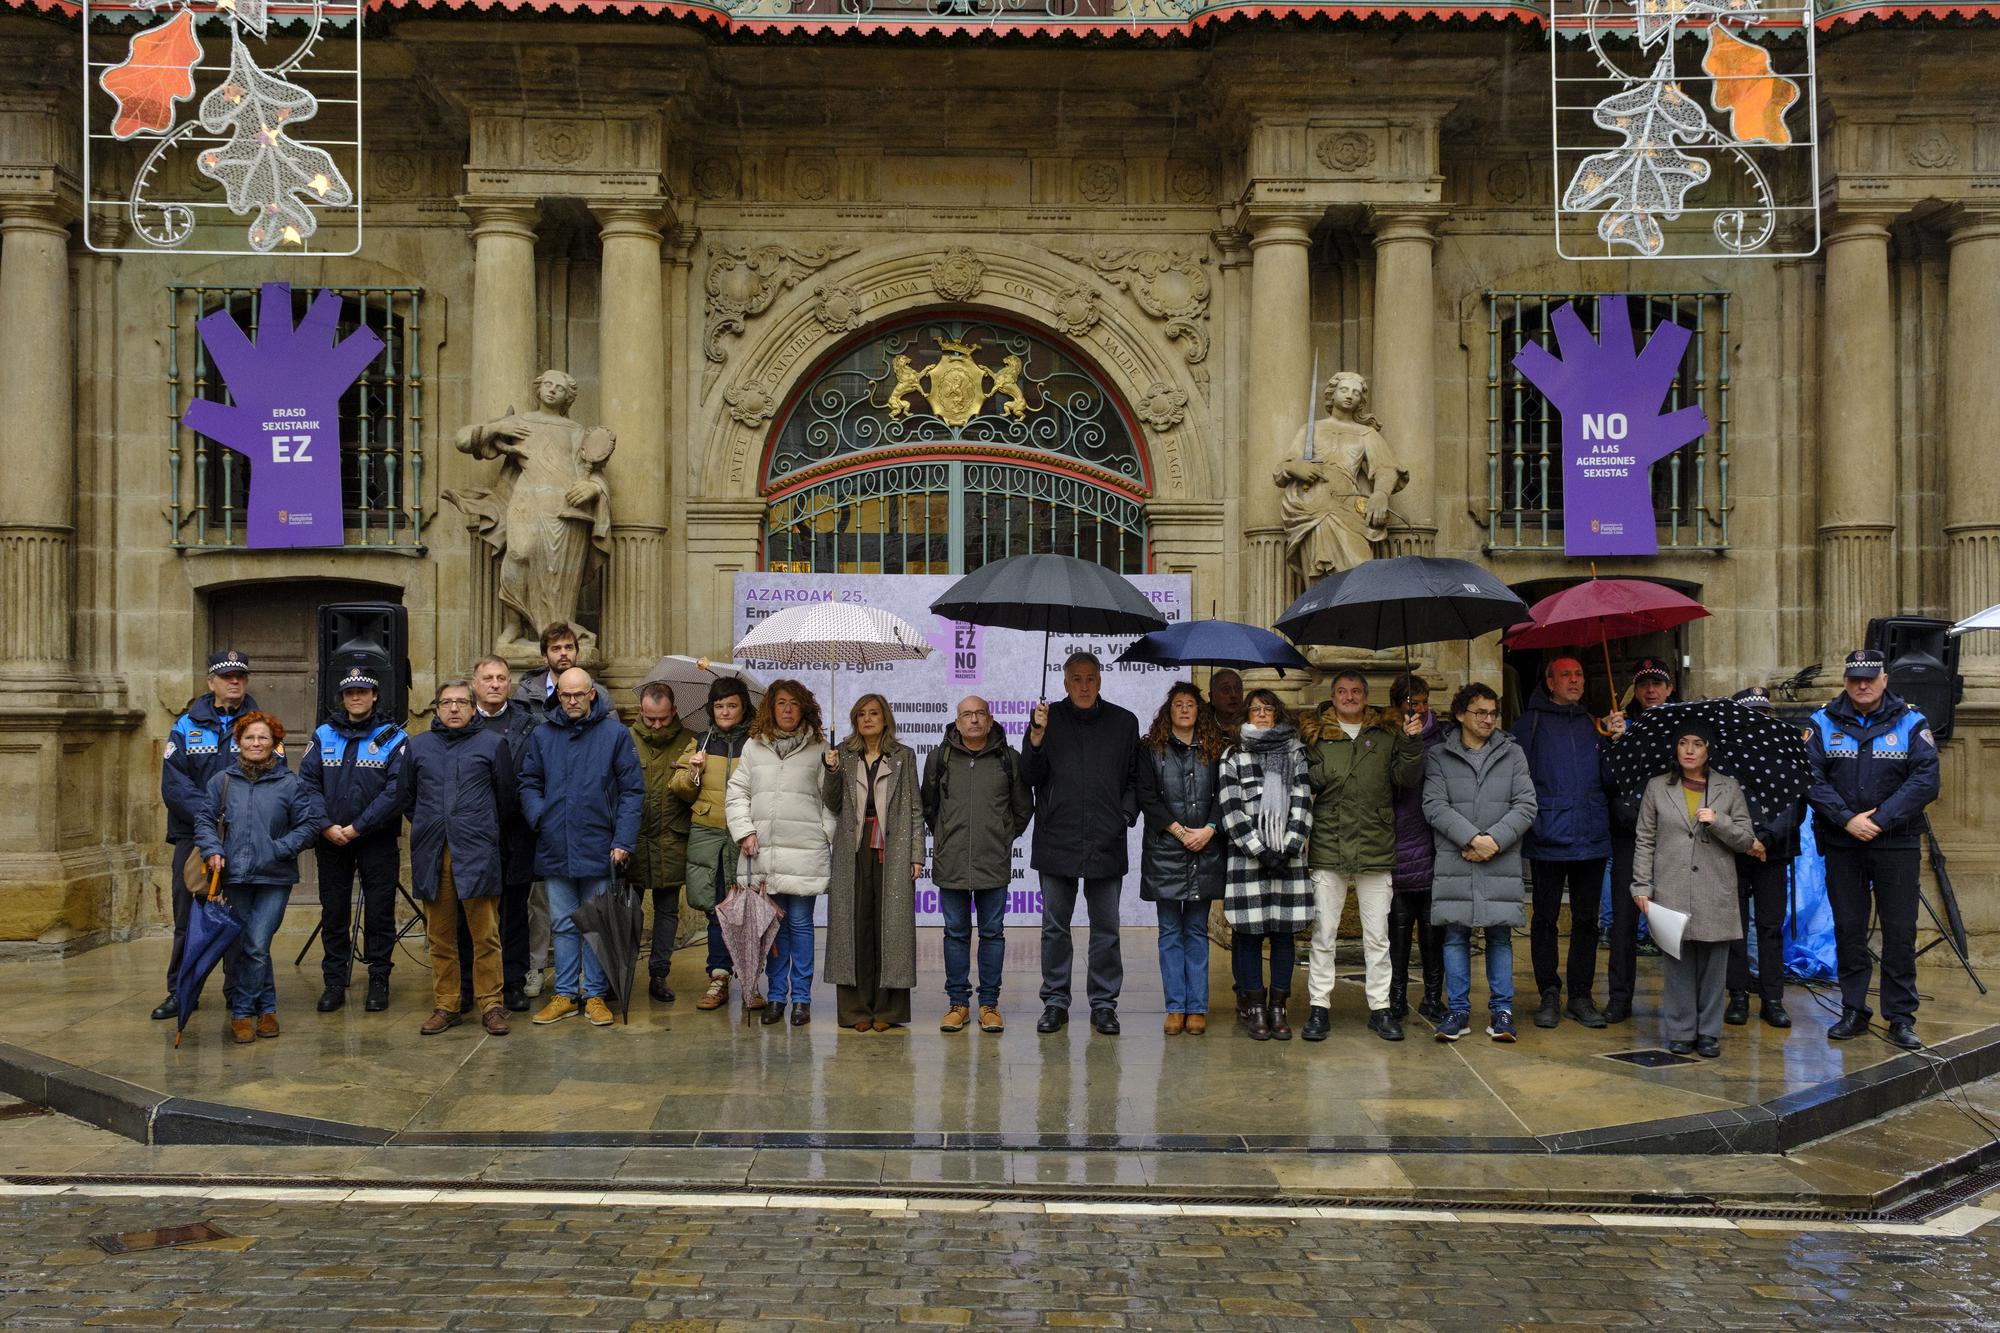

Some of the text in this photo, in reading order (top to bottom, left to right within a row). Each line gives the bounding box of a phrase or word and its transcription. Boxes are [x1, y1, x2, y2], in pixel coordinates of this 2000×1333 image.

[731, 438, 747, 483] PATET
[1003, 281, 1035, 299] COR
[1103, 337, 1141, 380] VALDE
[1164, 439, 1183, 489] MAGIS
[272, 408, 306, 417] ERASO
[262, 420, 320, 431] SEXISTARIK
[1582, 413, 1628, 440] NO
[271, 435, 313, 463] EZ
[1591, 445, 1620, 453] A LAS
[1576, 456, 1636, 466] AGRESIONES
[1583, 468, 1628, 477] SEXISTAS
[746, 589, 867, 604] AZAROAK 25,
[955, 630, 976, 649] EZ
[1065, 644, 1083, 654] de
[1089, 644, 1102, 654] la
[955, 652, 976, 669] NO
[889, 702, 948, 713] EMINICIDIOS
[896, 723, 943, 733] NIZIDIOAK
